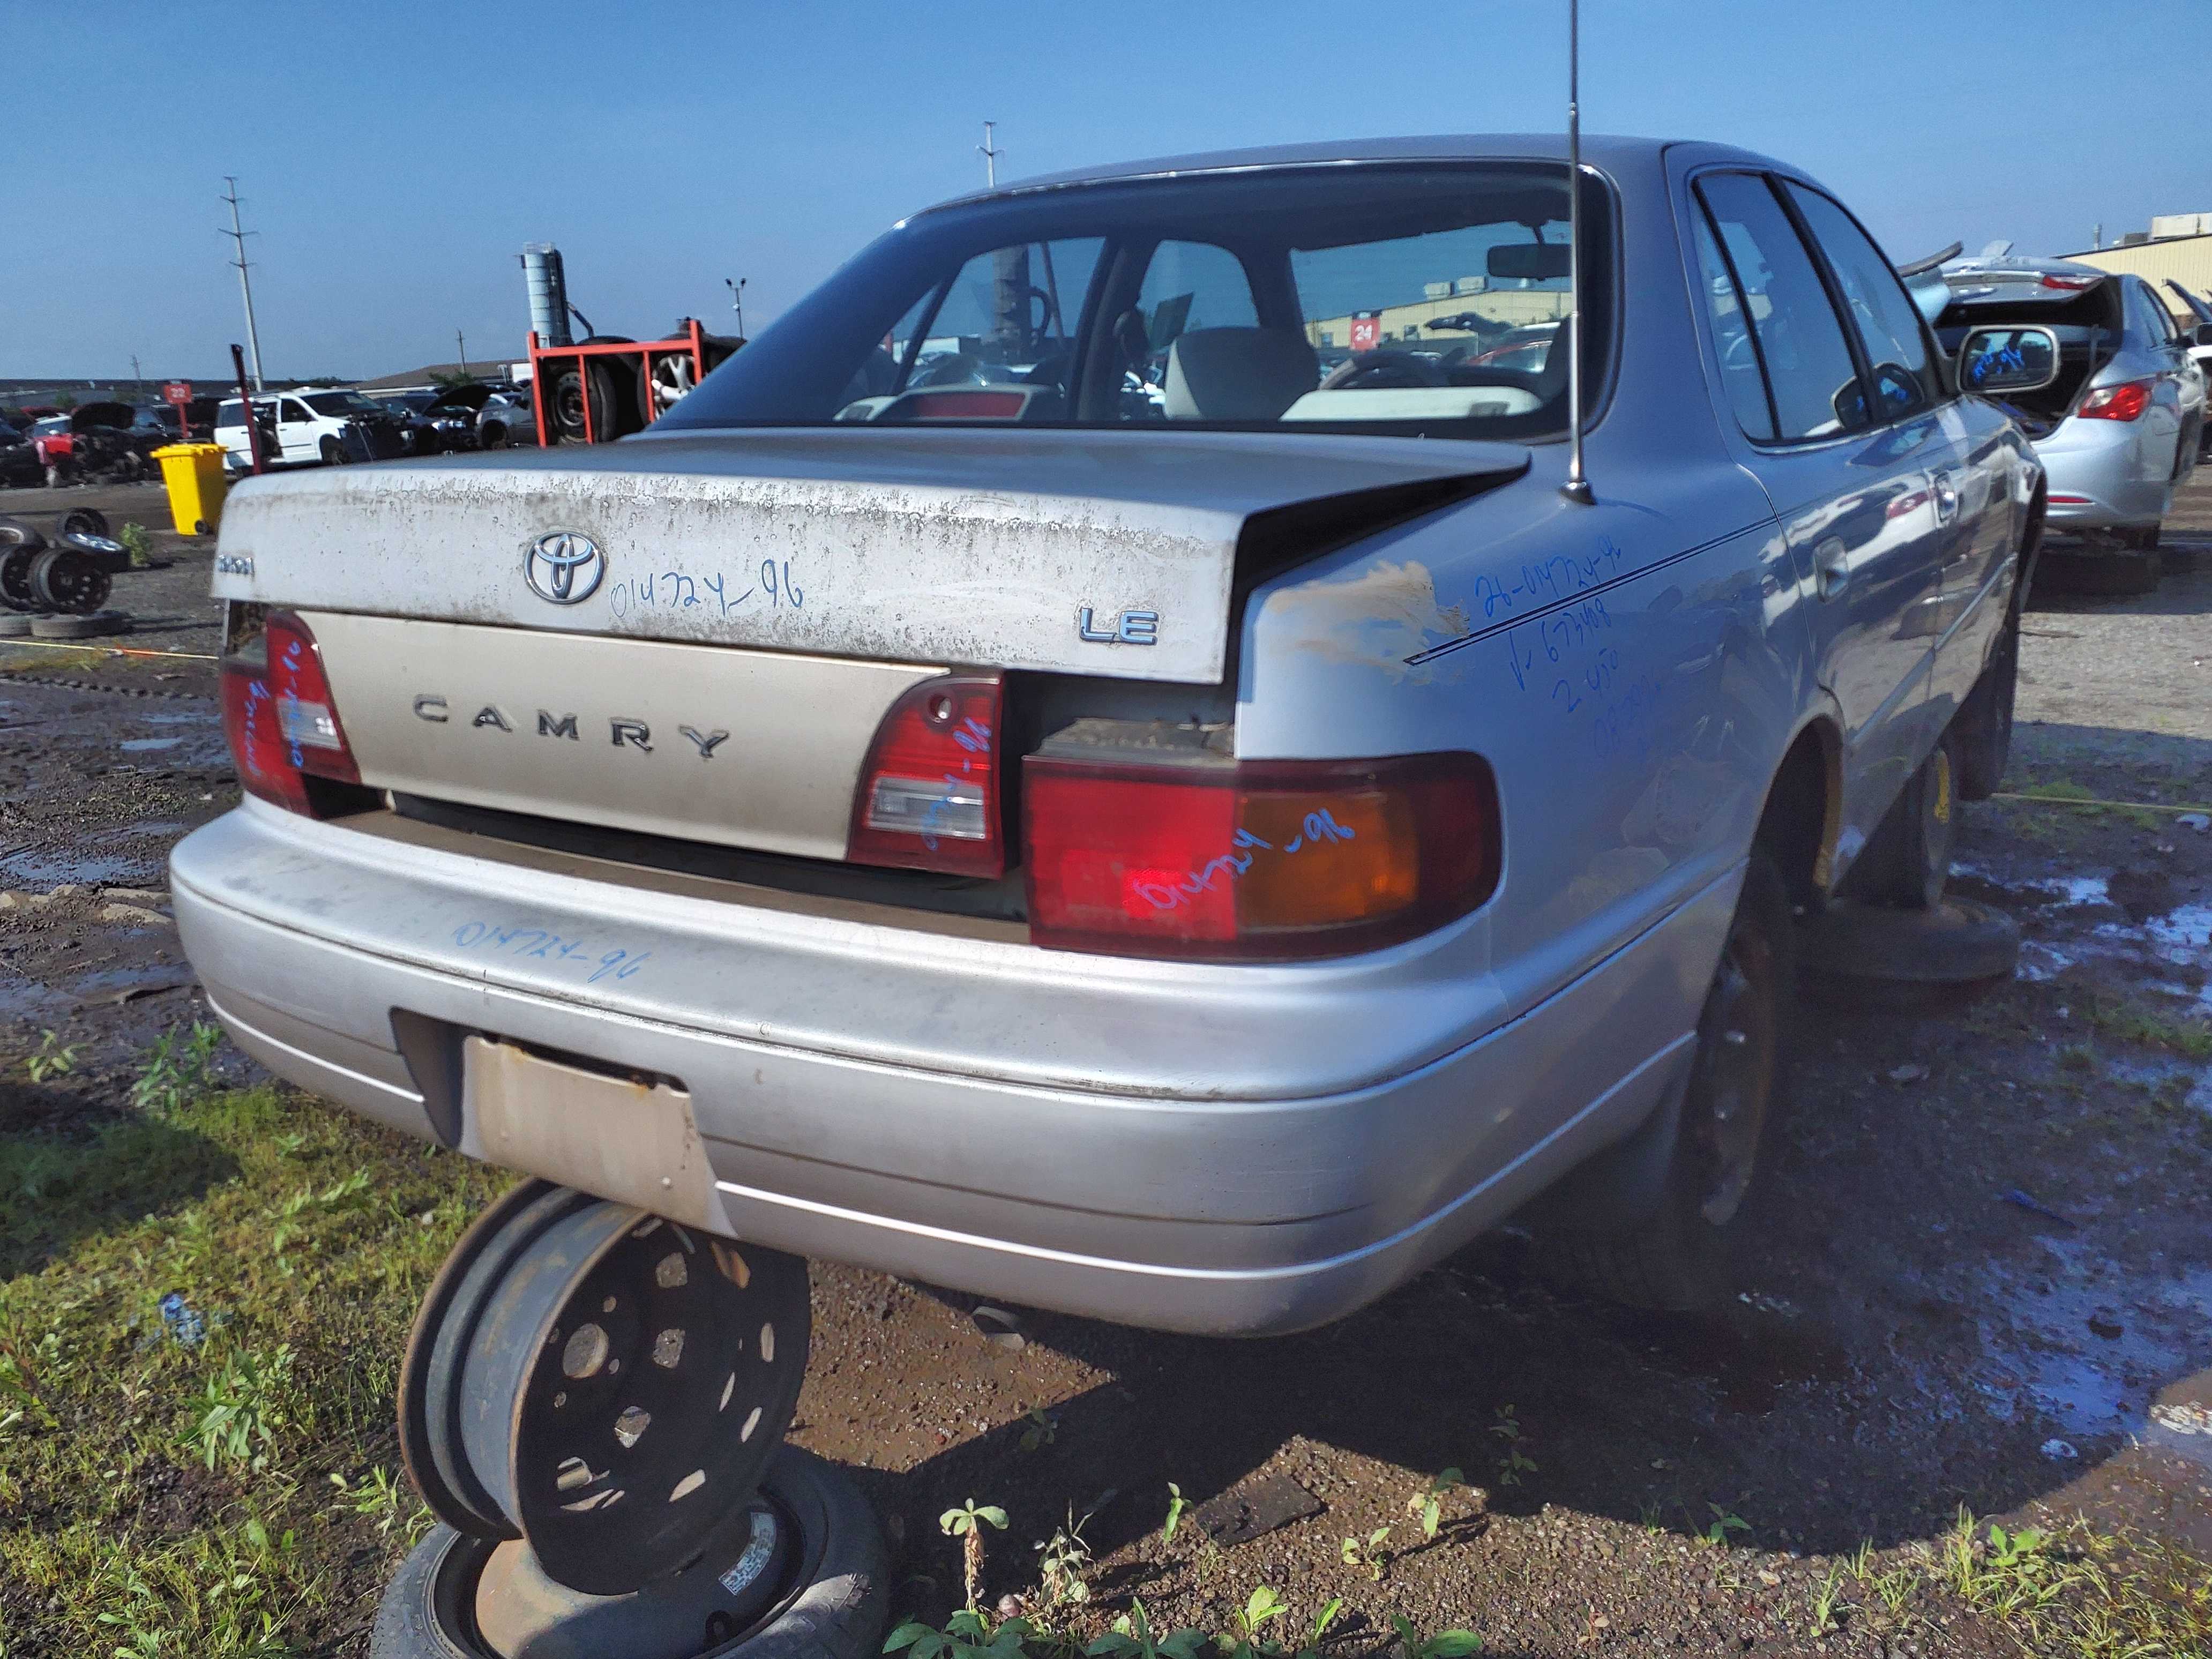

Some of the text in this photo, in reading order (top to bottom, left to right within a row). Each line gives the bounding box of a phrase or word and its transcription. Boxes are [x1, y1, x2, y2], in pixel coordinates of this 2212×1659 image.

[1355, 325, 1372, 341] 24
[1079, 608, 1159, 646] LE
[413, 693, 730, 758] CAMRY
